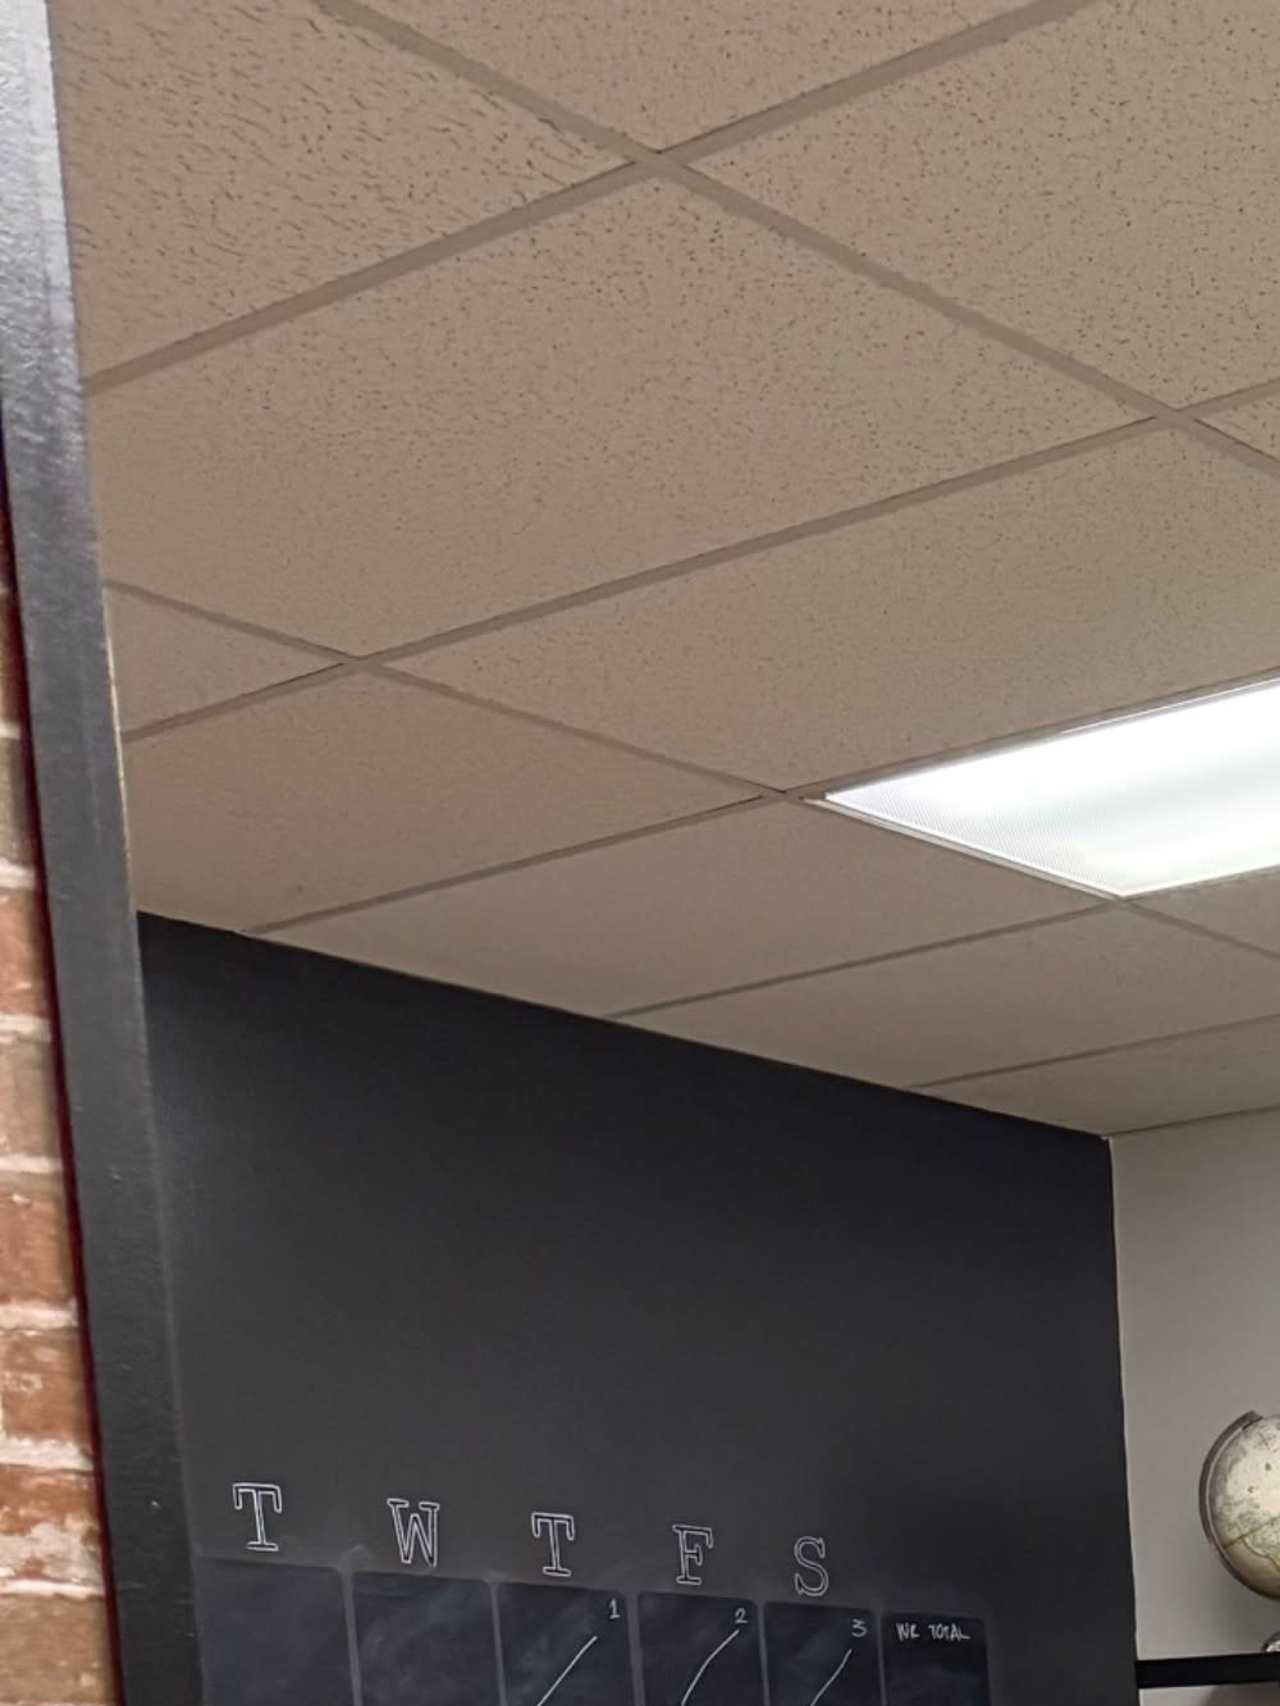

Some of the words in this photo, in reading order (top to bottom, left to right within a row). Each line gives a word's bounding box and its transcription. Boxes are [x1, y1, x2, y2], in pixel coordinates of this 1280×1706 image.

[232, 1481, 283, 1552] T
[386, 1497, 441, 1568] W
[530, 1511, 576, 1578] T
[671, 1523, 714, 1586] F
[793, 1535, 829, 1597] S
[609, 1598, 621, 1620] 1
[734, 1607, 749, 1624] 2
[851, 1618, 868, 1638] 3
[927, 1623, 971, 1641] TOTAL
